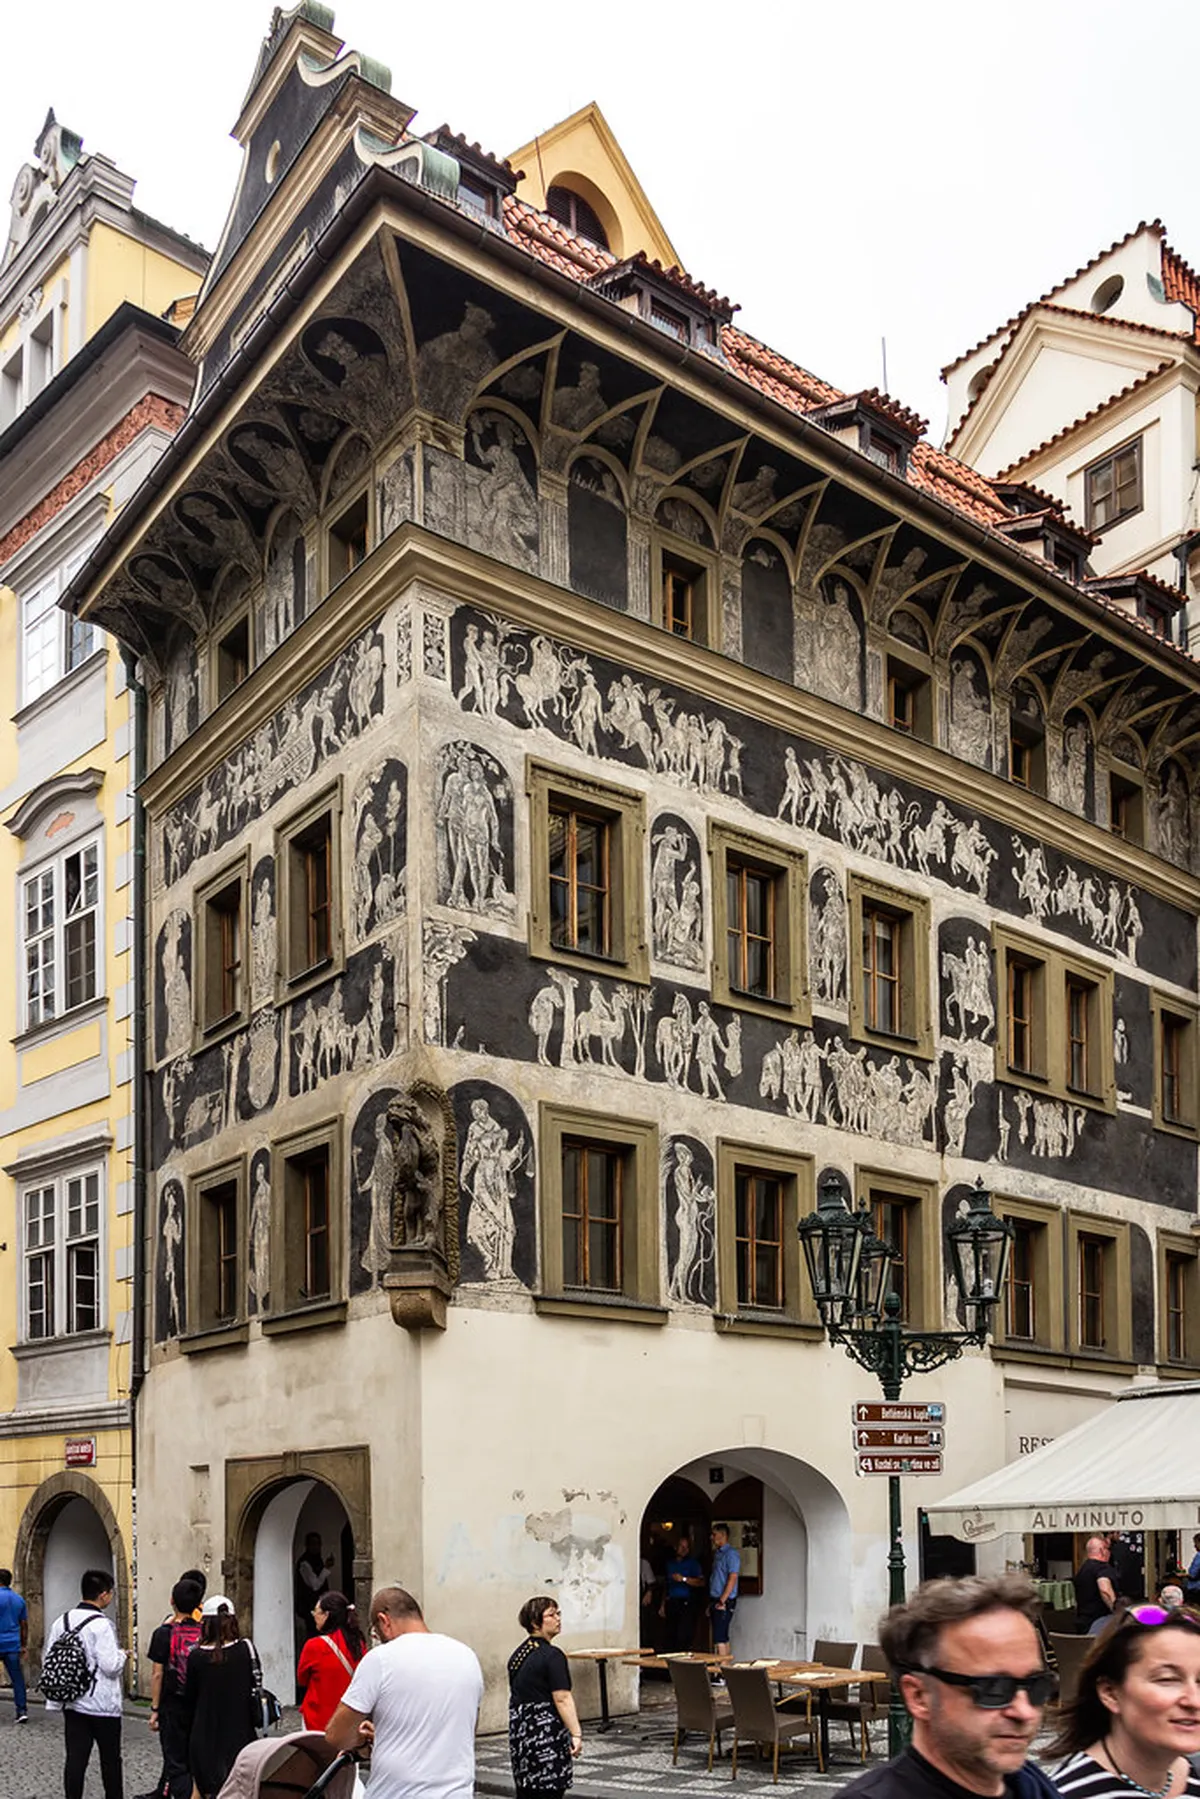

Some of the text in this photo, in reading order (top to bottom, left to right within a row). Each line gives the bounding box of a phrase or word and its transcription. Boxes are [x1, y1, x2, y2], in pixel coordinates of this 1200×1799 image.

[1019, 1436, 1054, 1453] RES
[1033, 1510, 1144, 1528] AL MINUTO
